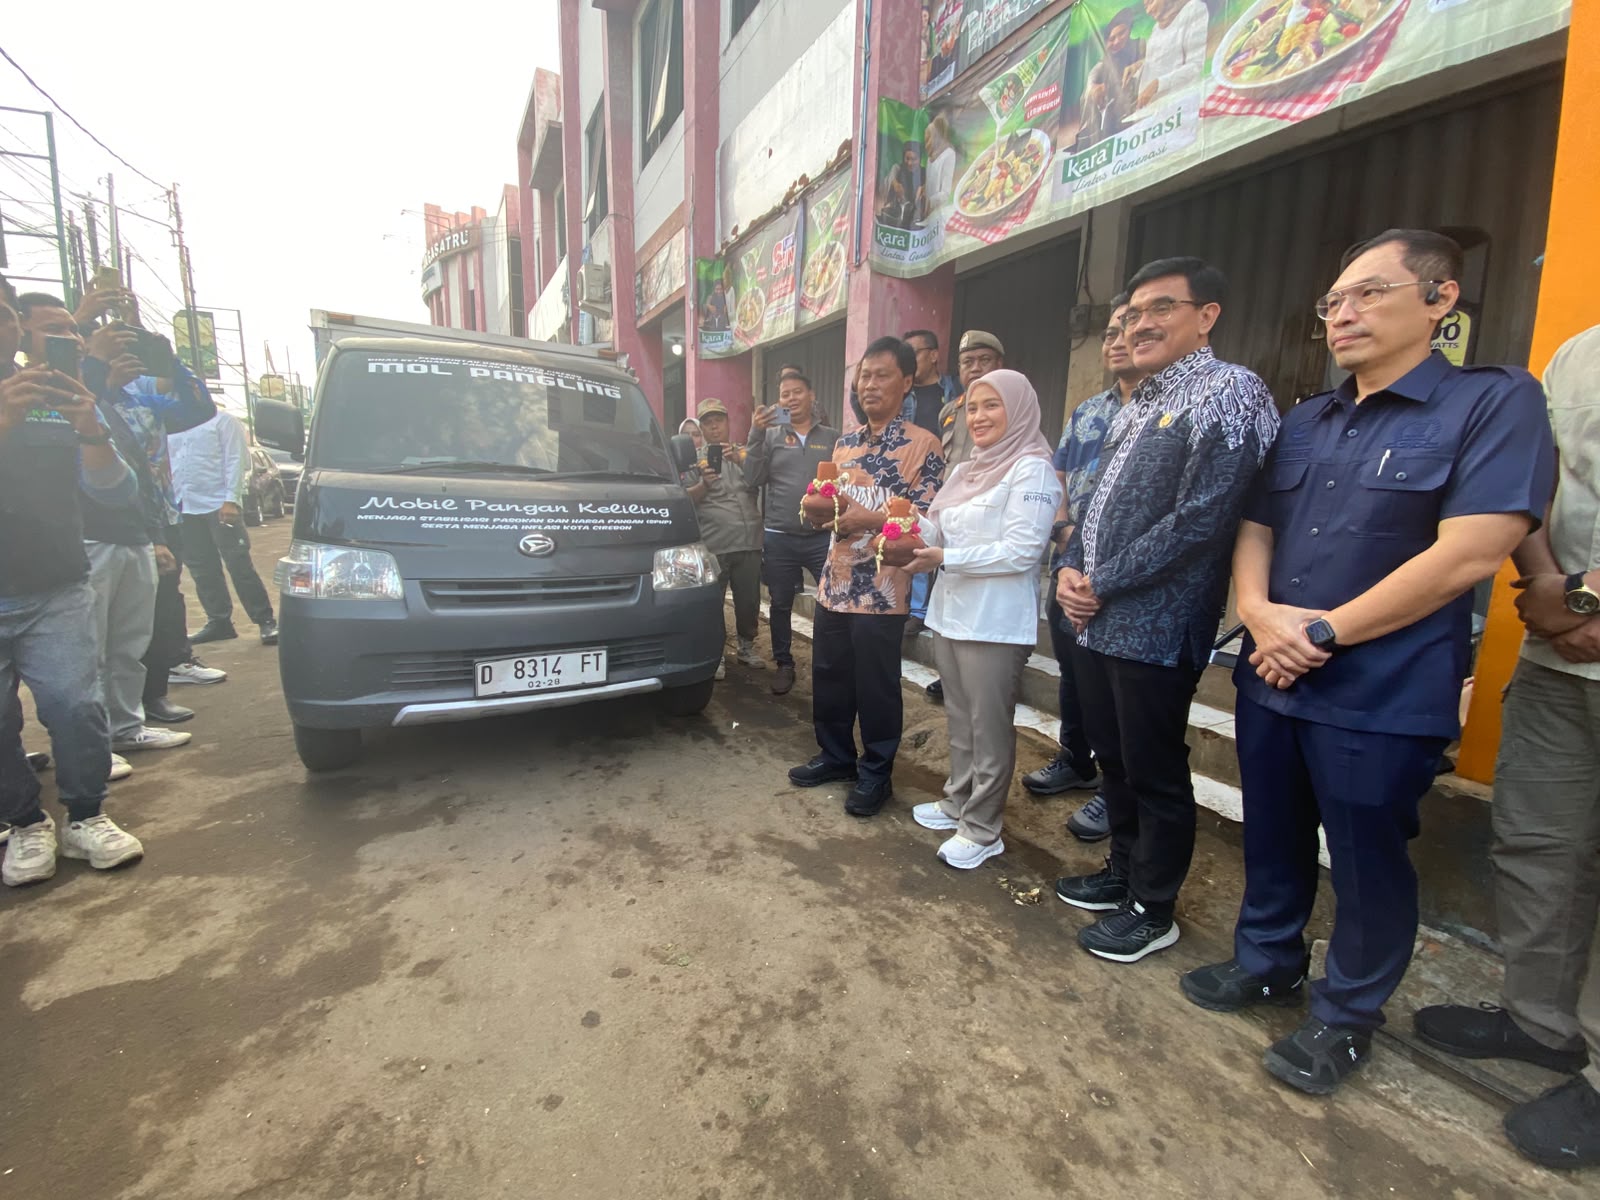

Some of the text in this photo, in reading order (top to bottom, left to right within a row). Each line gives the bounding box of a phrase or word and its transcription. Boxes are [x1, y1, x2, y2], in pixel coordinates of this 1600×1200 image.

[1067, 106, 1182, 178] kara borasi
[1111, 142, 1168, 175] Generasi
[877, 225, 906, 248] kara
[359, 496, 670, 518] Mobil Pangan Keliling
[419, 515, 490, 523] STABILISASI
[481, 652, 603, 685] D 8314 FT
